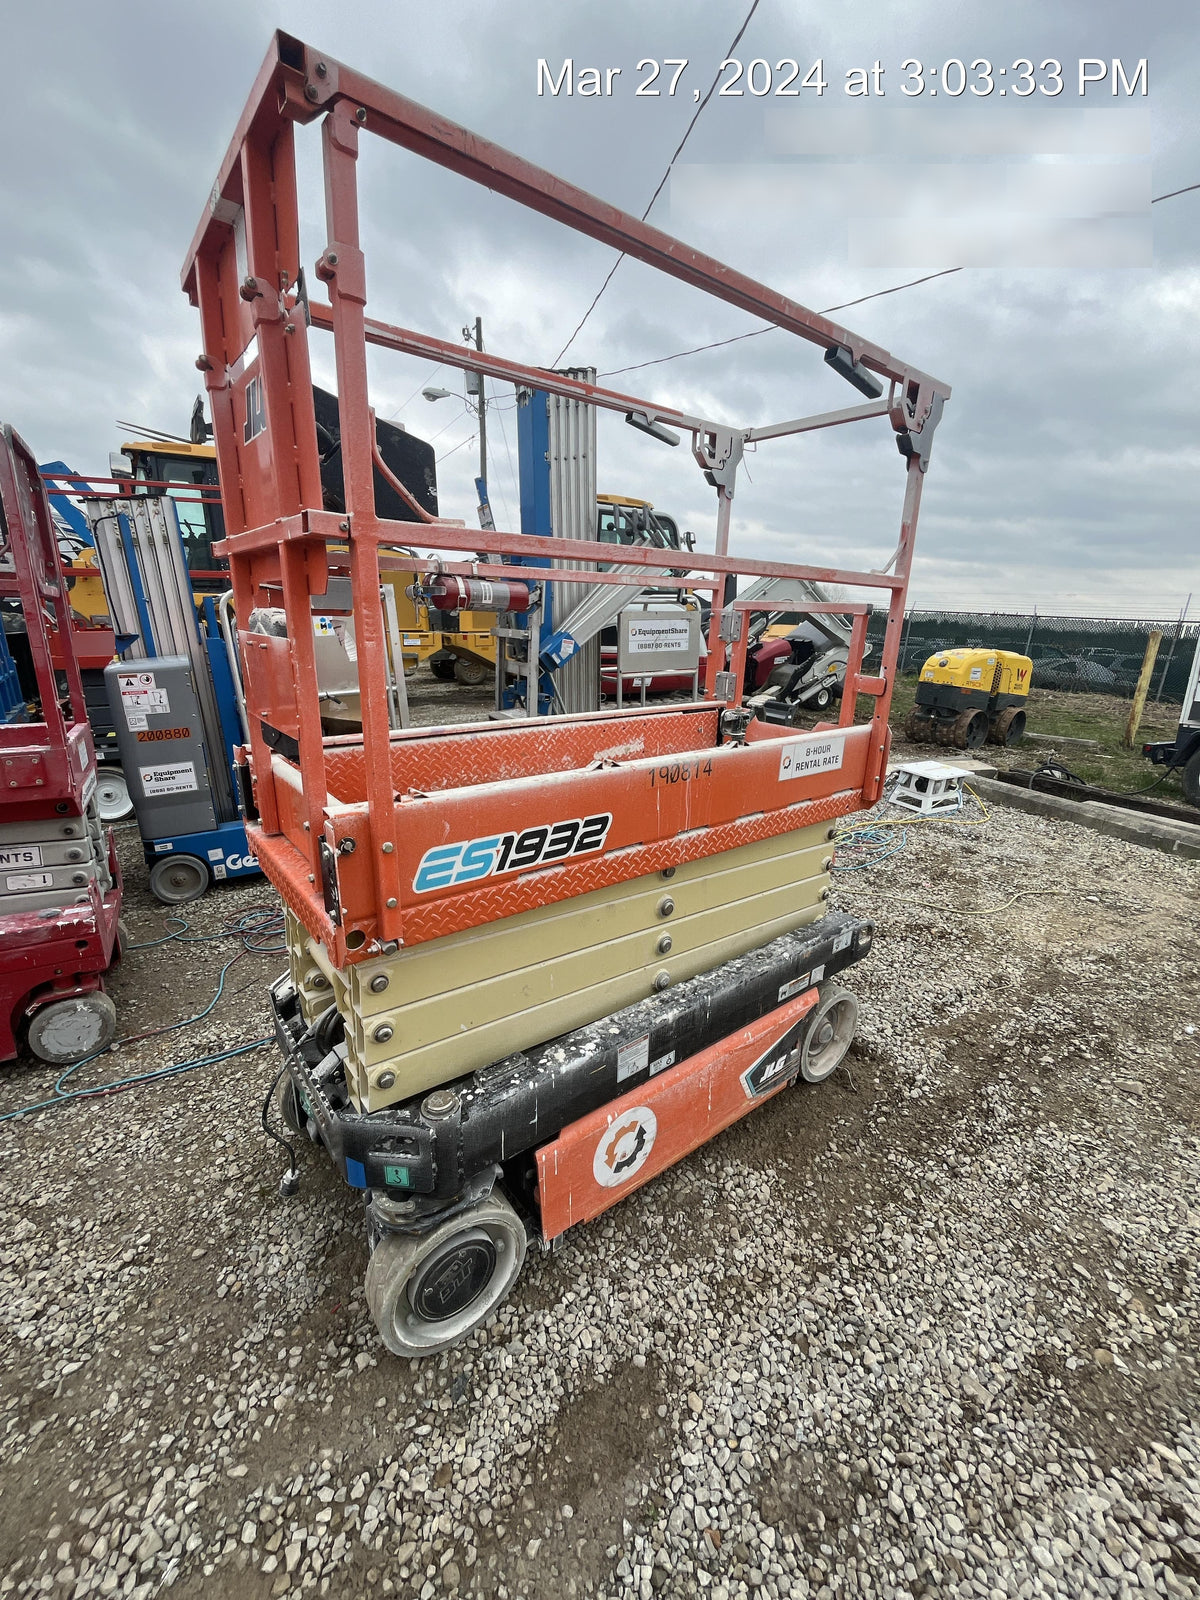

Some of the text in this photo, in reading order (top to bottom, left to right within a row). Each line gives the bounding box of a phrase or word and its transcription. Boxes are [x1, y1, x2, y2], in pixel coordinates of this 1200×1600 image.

[638, 628, 687, 636] EquipmentShare
[138, 728, 190, 741] 200880
[805, 745, 831, 757] 8-HOUR
[795, 755, 839, 772] RENTAL RATE
[153, 768, 192, 777] Equipment
[648, 758, 713, 788] 190814
[413, 813, 612, 893] ES1932
[759, 1054, 787, 1083] JLG
